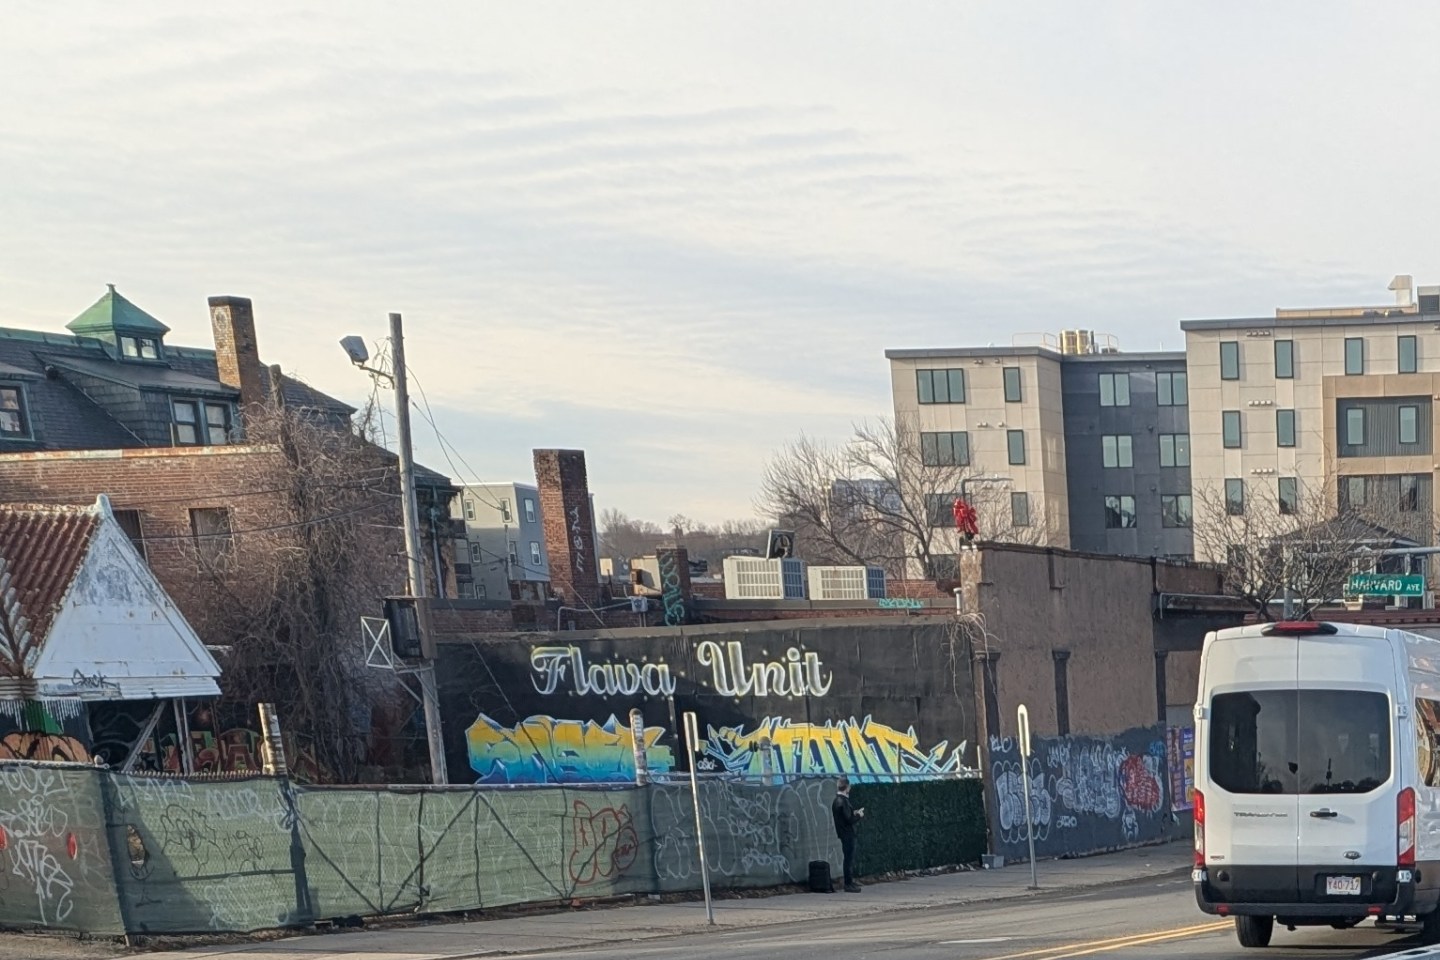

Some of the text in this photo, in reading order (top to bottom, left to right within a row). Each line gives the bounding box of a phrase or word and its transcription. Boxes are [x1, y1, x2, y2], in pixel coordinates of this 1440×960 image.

[1351, 579, 1402, 591] HARVARD
[530, 639, 832, 697] Flava Unit
